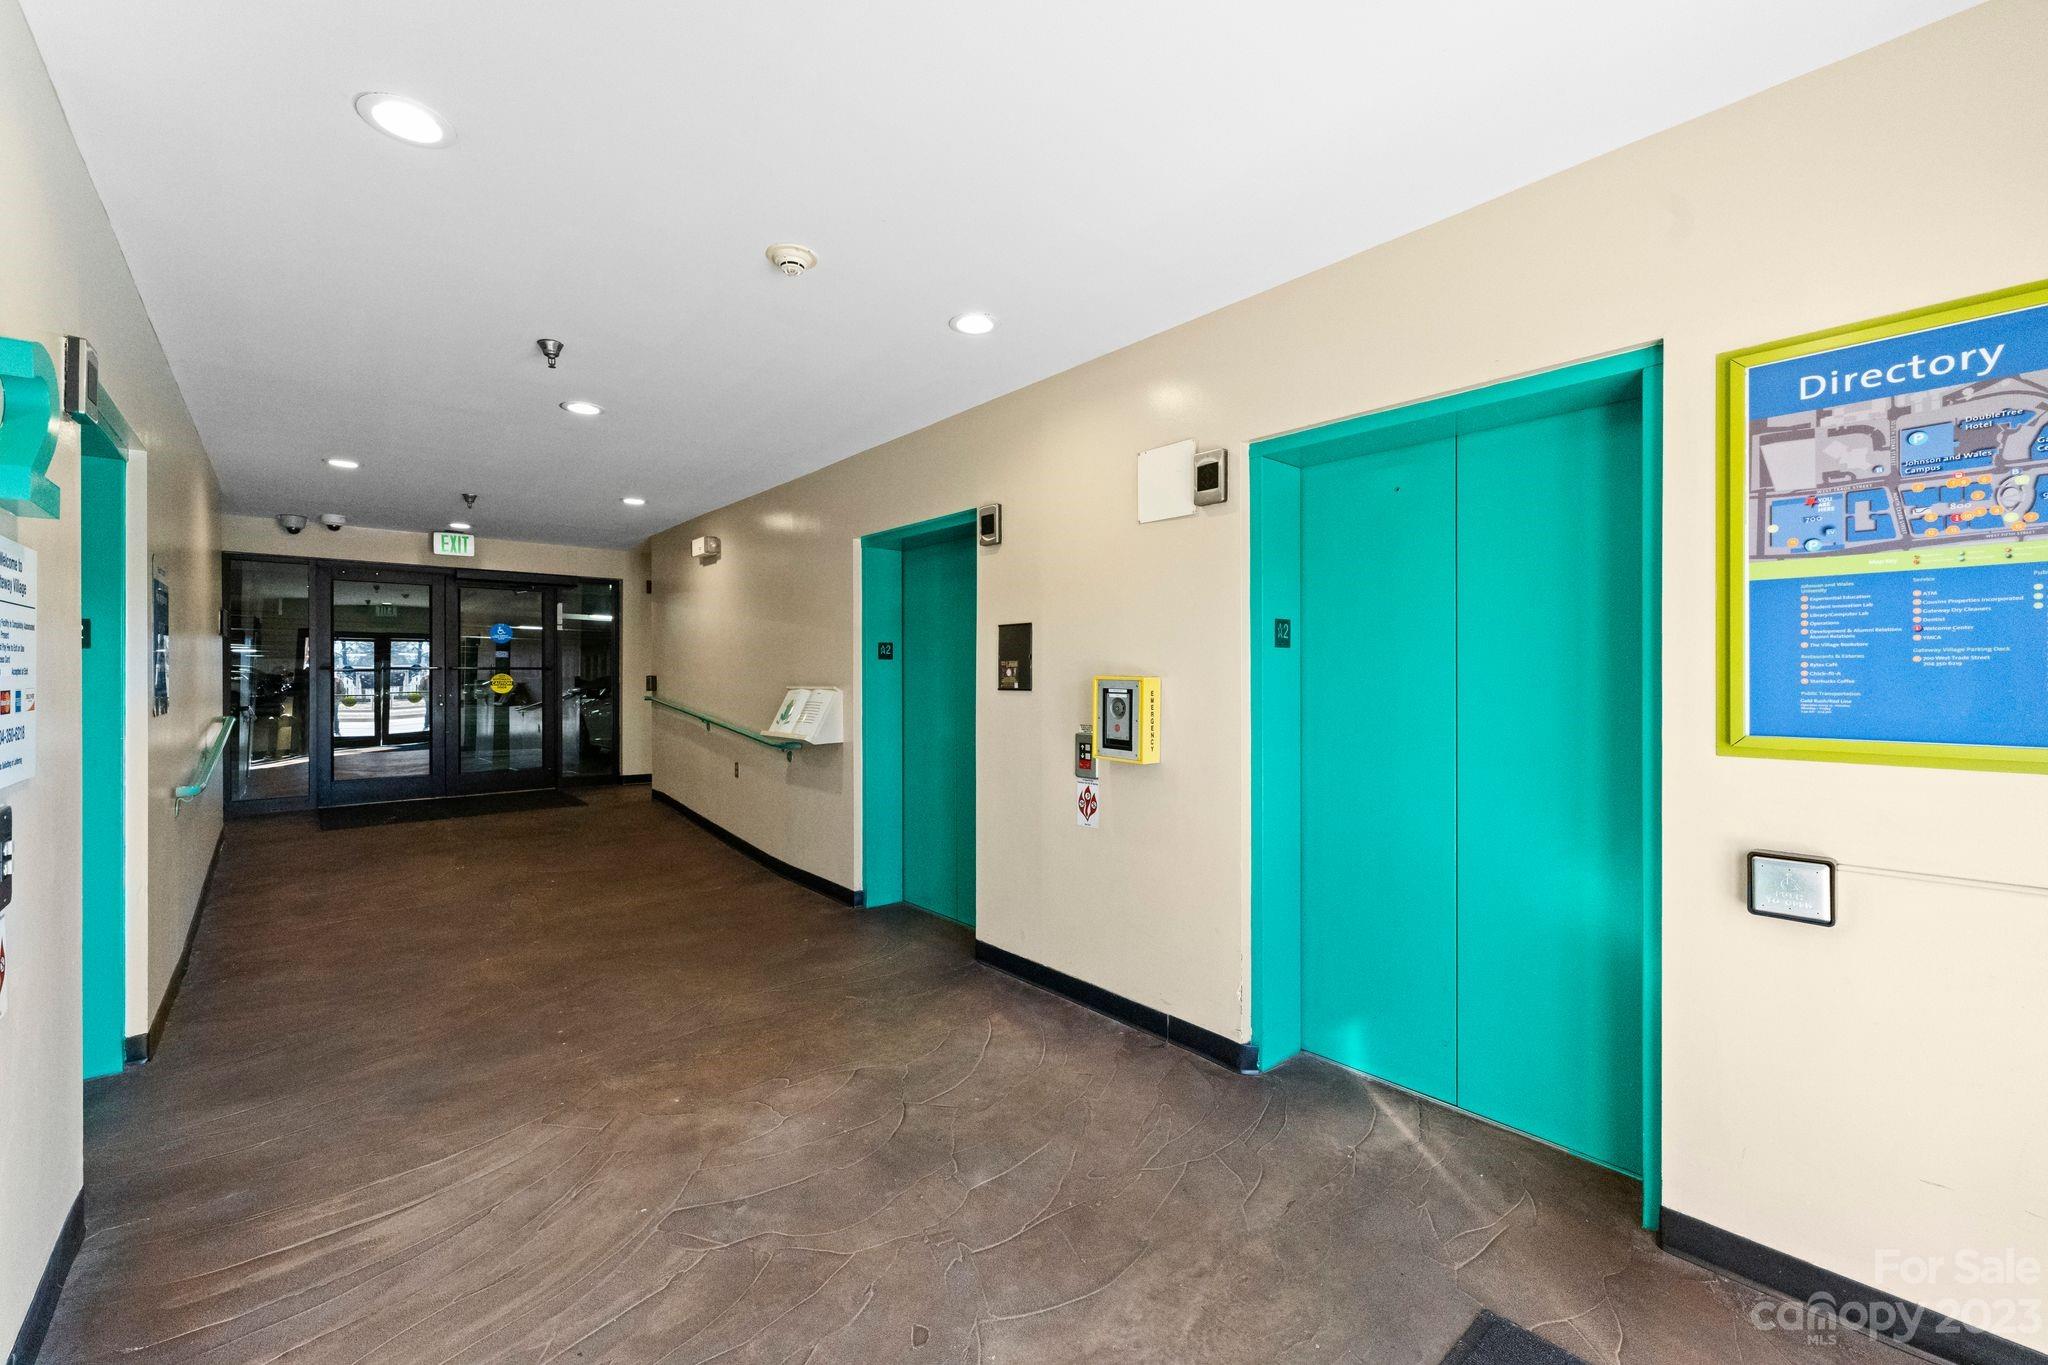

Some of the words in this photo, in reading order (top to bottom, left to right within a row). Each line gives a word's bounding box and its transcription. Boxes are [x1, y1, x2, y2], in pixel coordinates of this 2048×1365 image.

[1799, 343, 2005, 400] Directory
[1965, 408, 2023, 423] DoubleTree
[1965, 421, 1993, 431] Hotel
[1903, 457, 1941, 467] Johnson
[1943, 453, 1960, 462] and
[1963, 450, 1993, 459] Wales
[1904, 464, 1941, 475] Campus
[441, 534, 469, 553] EXIT
